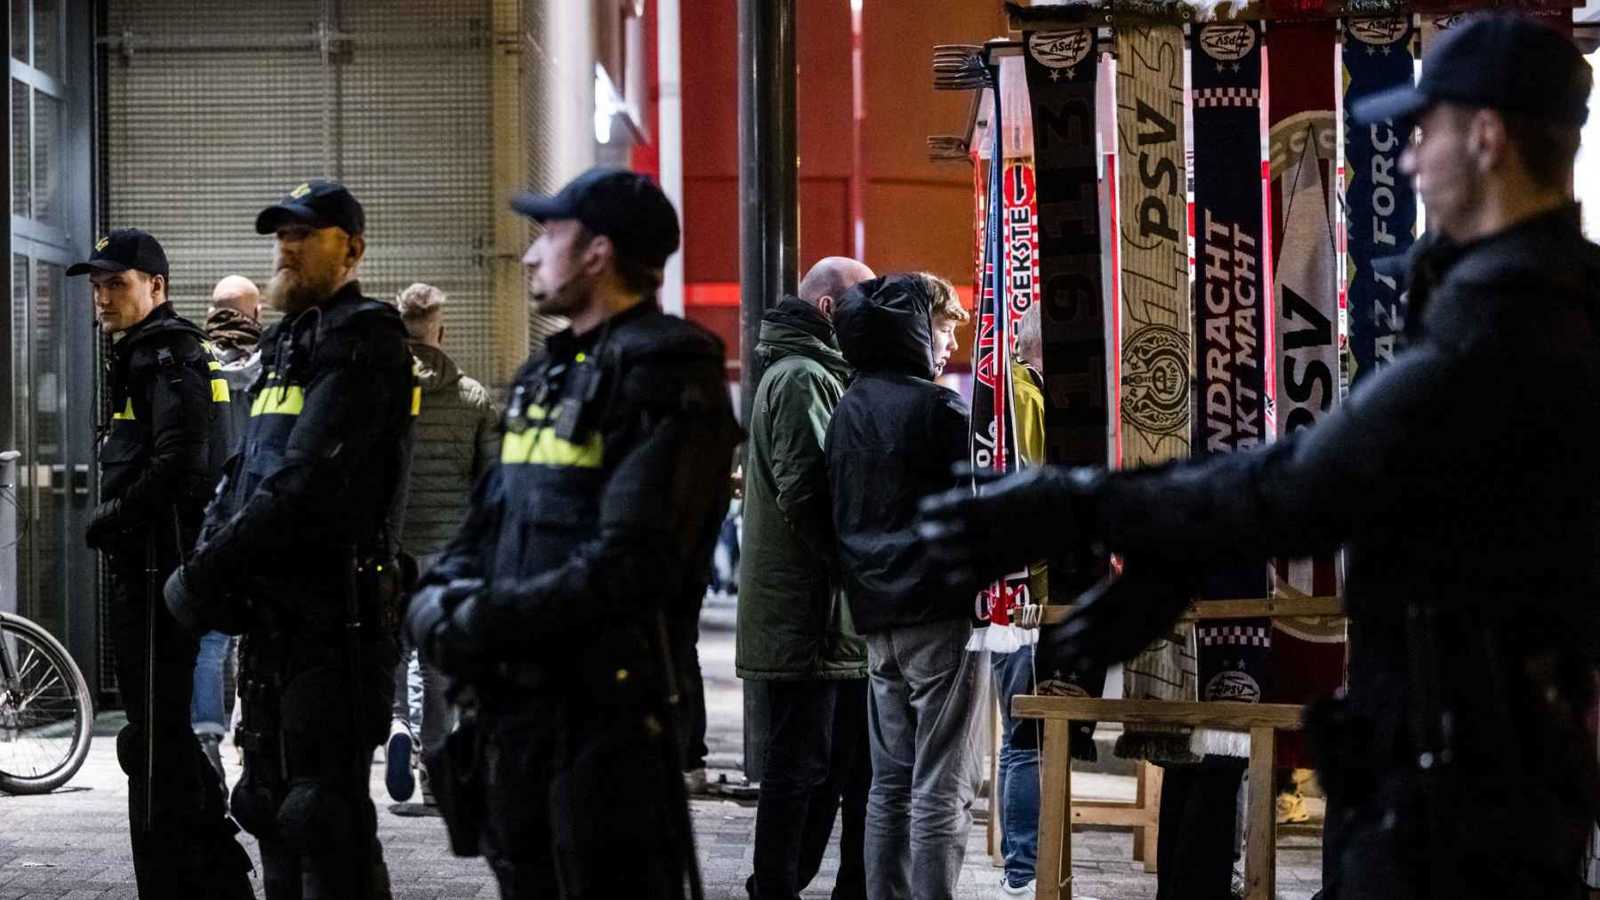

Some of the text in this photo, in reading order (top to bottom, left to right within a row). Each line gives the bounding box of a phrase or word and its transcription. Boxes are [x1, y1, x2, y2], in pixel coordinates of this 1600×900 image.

[1050, 39, 1074, 52] PSV
[1214, 36, 1239, 47] PSV
[1137, 97, 1179, 242] PSV
[1372, 115, 1399, 246] FORÇ
[1011, 206, 1031, 311] GEKSTE
[1234, 223, 1257, 368] MACHT
[1374, 298, 1397, 372] AZ
